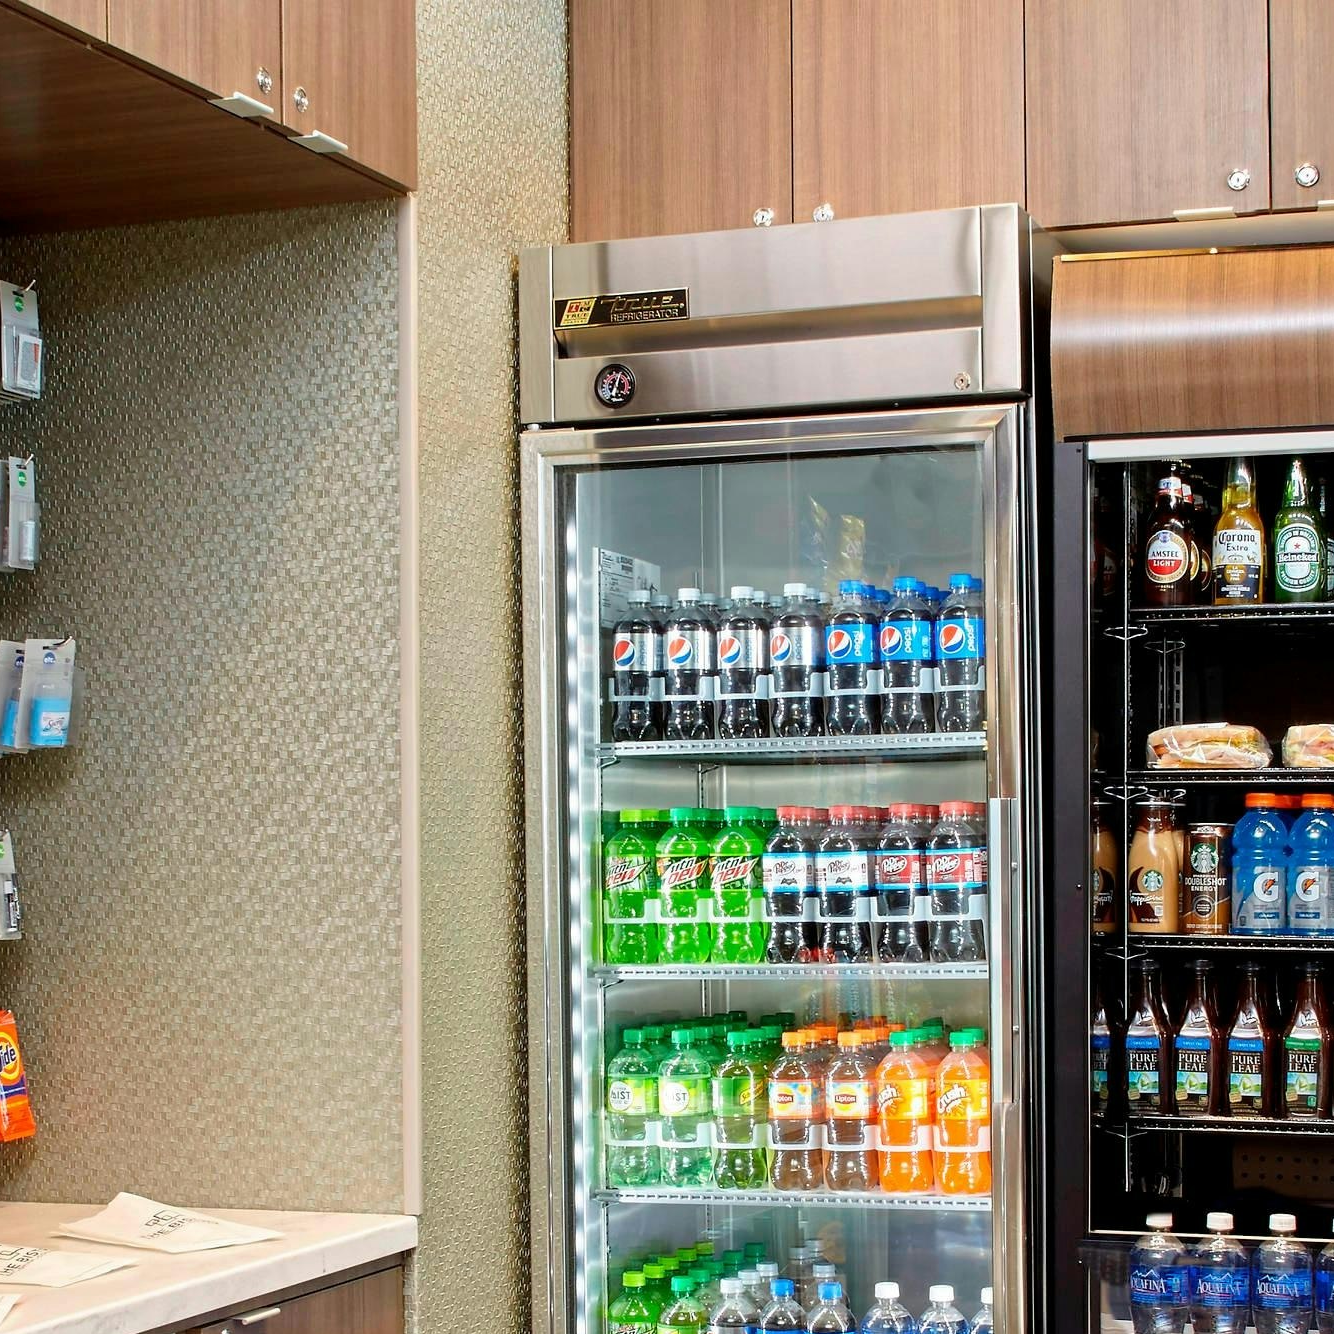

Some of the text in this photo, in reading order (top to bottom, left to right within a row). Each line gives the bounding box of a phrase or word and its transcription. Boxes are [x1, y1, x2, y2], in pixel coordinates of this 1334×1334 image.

[611, 308, 678, 322] REFRIGERATOR
[1219, 531, 1256, 545] Corona
[1226, 543, 1249, 552] Extra
[1153, 559, 1176, 567] LIGHT
[1278, 553, 1318, 563] Heineken
[903, 626, 913, 655] pepsi
[1184, 877, 1227, 887] DOUBLESHOT
[1129, 1053, 1157, 1063] PURE
[1178, 1053, 1207, 1063] PURE
[1232, 1055, 1260, 1065] PURE
[1289, 1053, 1317, 1063] PURE
[1130, 1062, 1156, 1071] LEAF
[1178, 1062, 1205, 1071] LEAF
[1232, 1064, 1259, 1073] LEAF
[1289, 1063, 1315, 1072] LEAF
[835, 1095, 856, 1103] Lipton
[1256, 1280, 1300, 1297] AQUAFINA
